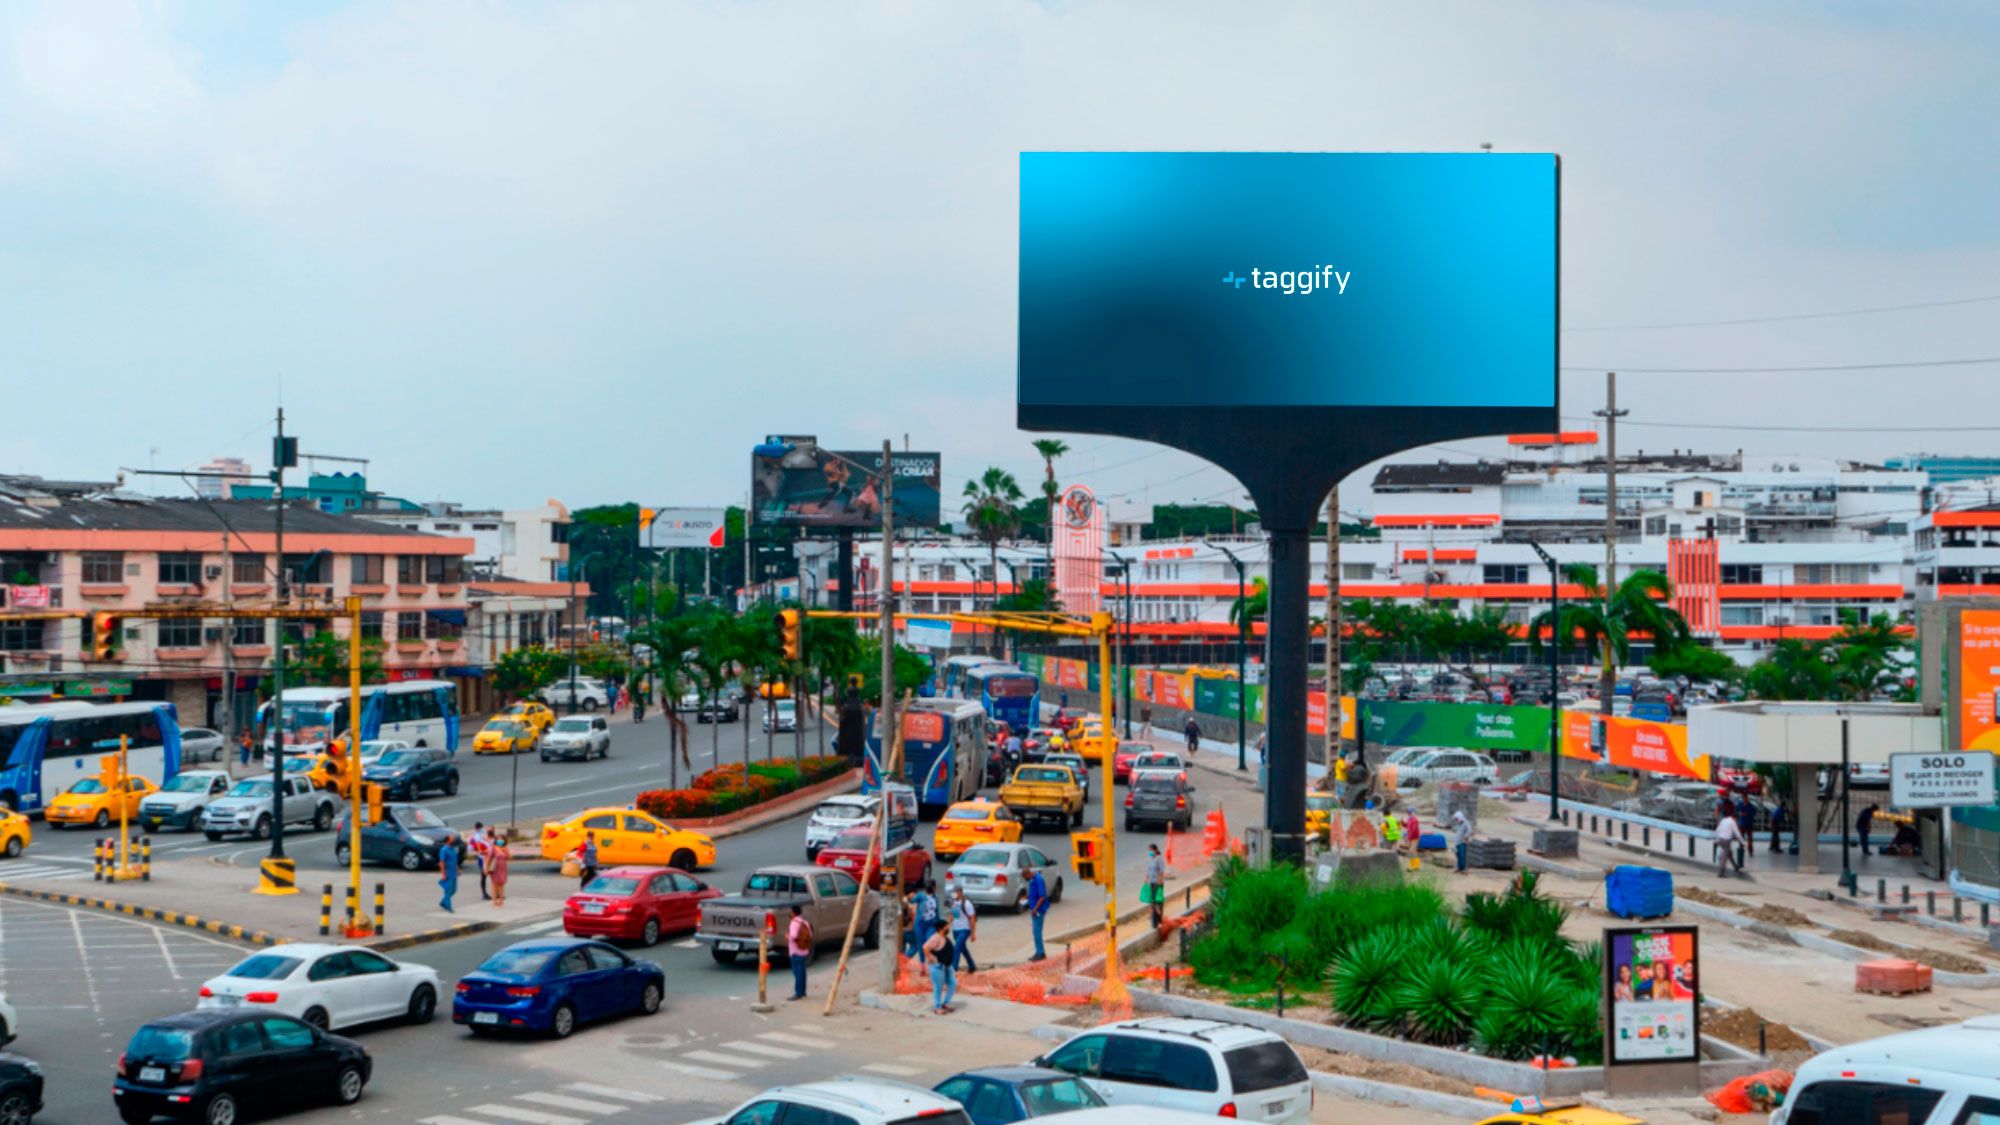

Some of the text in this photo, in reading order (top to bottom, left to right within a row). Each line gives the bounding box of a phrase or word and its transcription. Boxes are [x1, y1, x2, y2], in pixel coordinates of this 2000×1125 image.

[1251, 264, 1351, 295] taggify
[875, 457, 935, 468] DSTINADOS
[902, 467, 935, 476] CREAR
[1921, 757, 1965, 769] SOLO
[1943, 770, 1984, 778] RECOGER
[1911, 779, 1979, 787] PASAJEROS
[711, 915, 756, 928] TOYOTA
